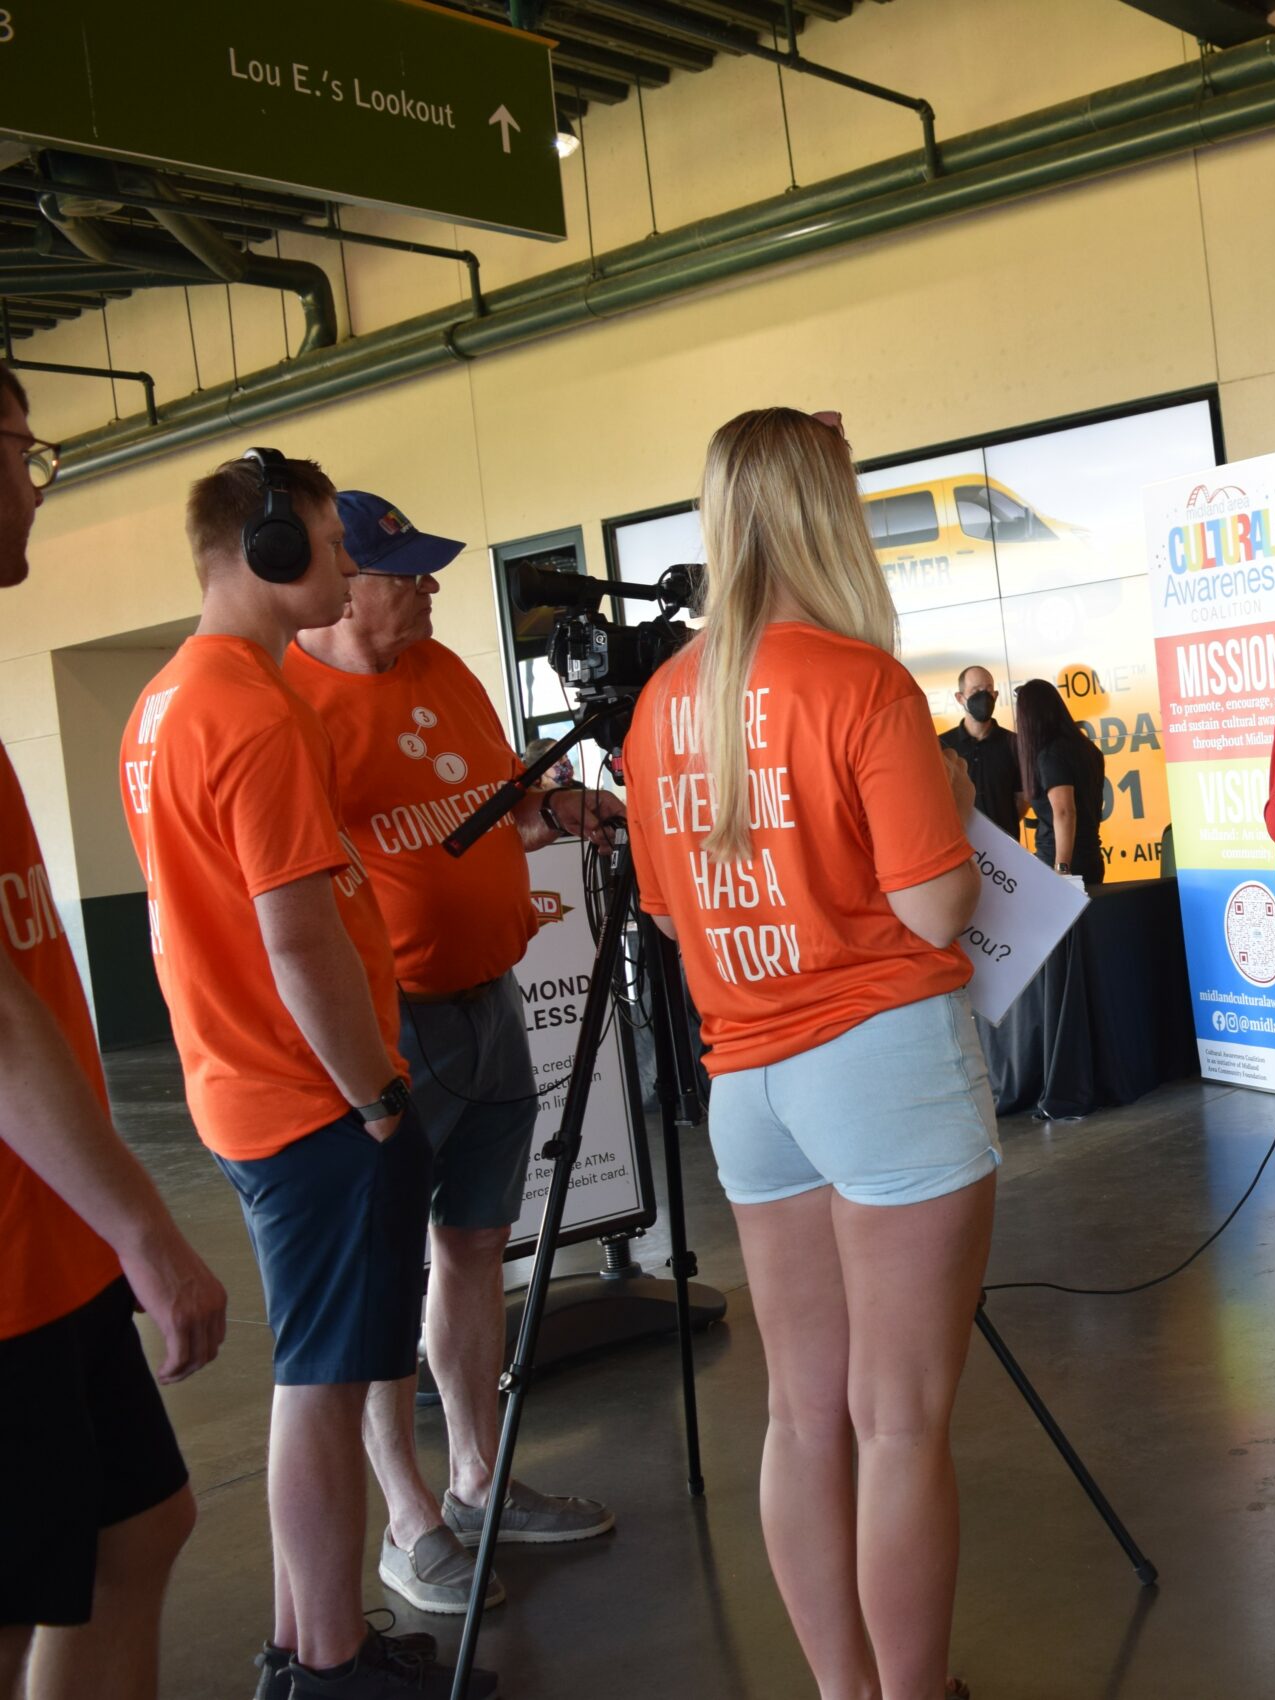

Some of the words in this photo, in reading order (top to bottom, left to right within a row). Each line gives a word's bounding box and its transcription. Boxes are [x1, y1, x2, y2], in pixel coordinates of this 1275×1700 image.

[229, 47, 281, 87] Lou
[292, 63, 344, 101] E.'s
[354, 78, 455, 129] Lookout
[1186, 500, 1225, 521] midland
[1227, 496, 1249, 511] area
[1191, 600, 1262, 623] COALITION
[1170, 703, 1183, 715] To
[1184, 701, 1224, 716] promote,
[1226, 696, 1273, 710] encourage,
[419, 710, 431, 724] 3
[1169, 721, 1187, 733] and
[1189, 718, 1220, 732] sustain
[1222, 714, 1256, 728] cultural
[407, 740, 418, 753] 2
[1193, 734, 1244, 749] throughout
[446, 762, 456, 775] 1
[1198, 768, 1269, 824] VISIO
[690, 851, 760, 910] HAS
[761, 848, 786, 907] A
[585, 1152, 616, 1168] ATMs
